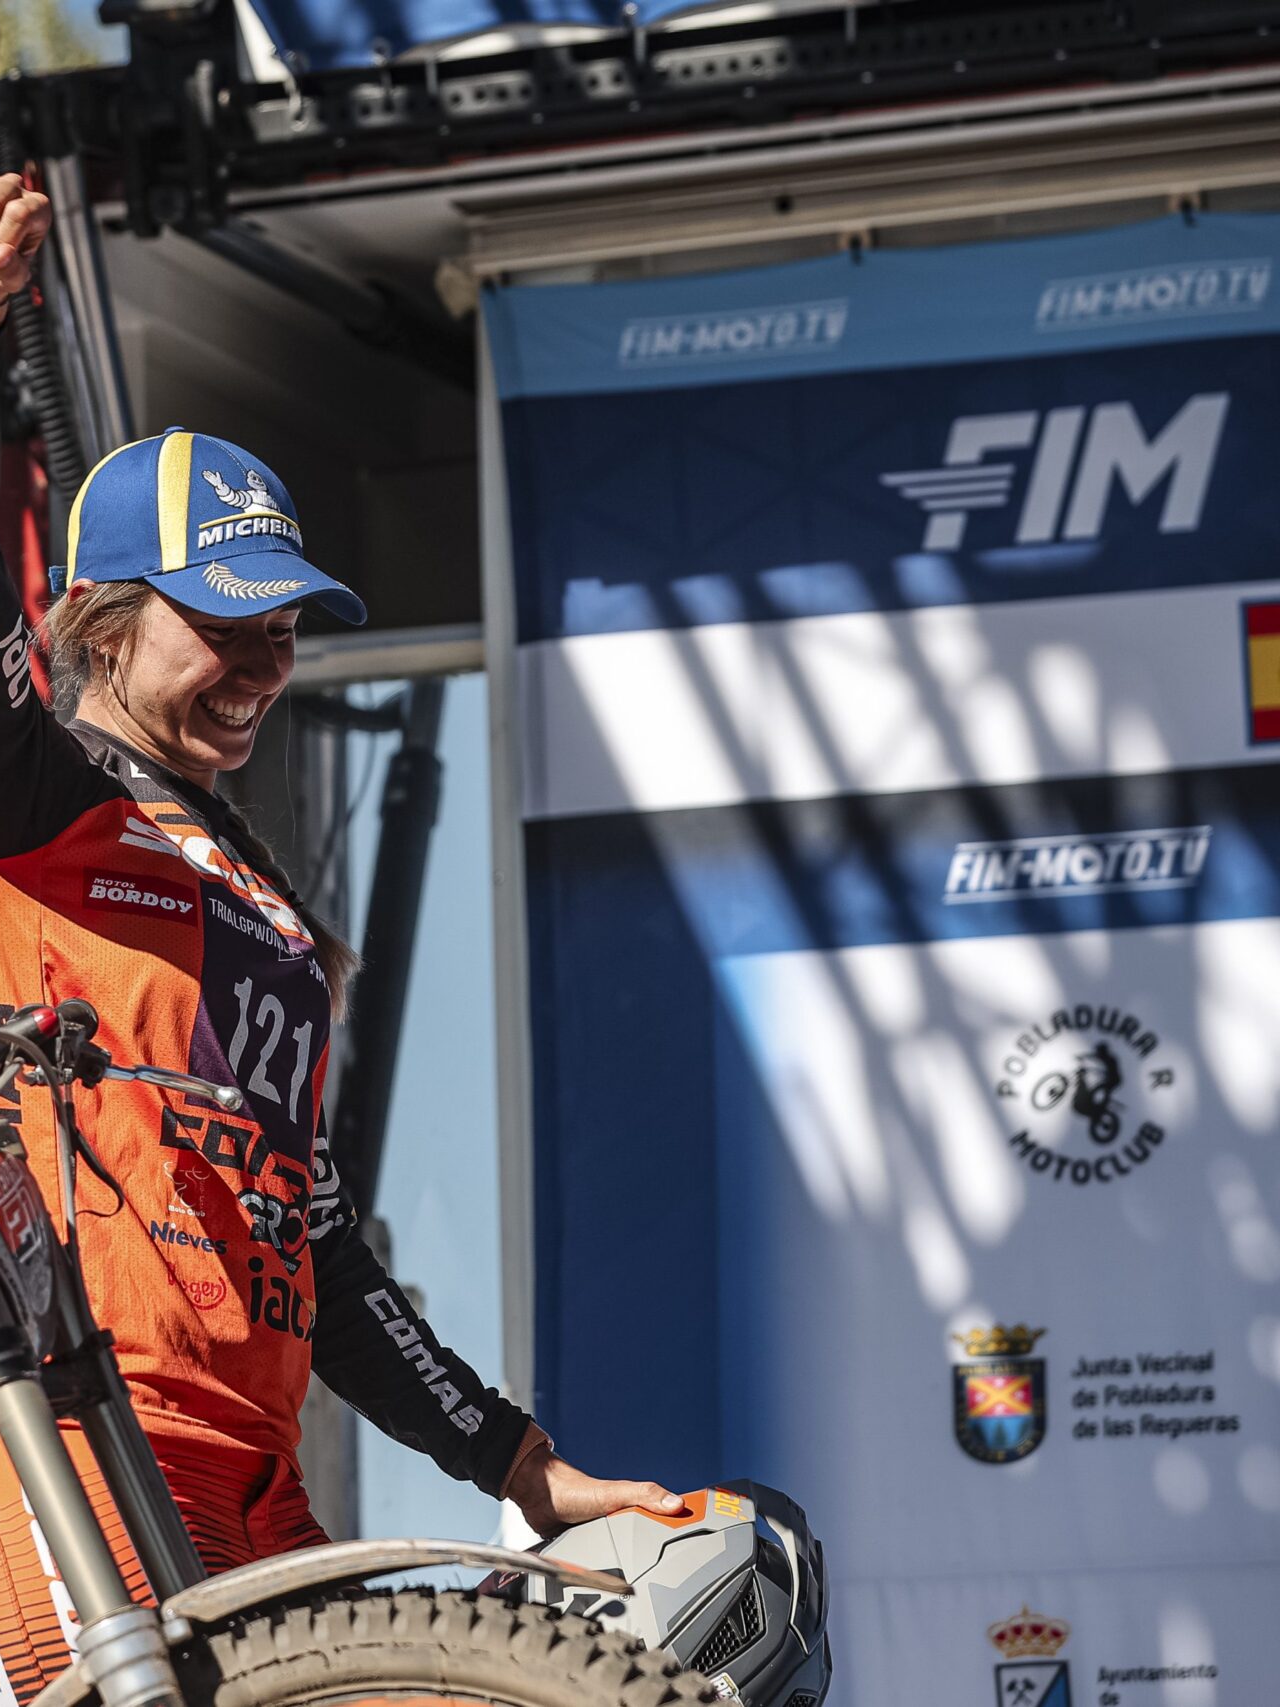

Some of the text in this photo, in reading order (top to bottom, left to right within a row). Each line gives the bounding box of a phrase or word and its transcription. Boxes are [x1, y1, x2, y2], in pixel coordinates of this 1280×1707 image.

[880, 392, 1229, 550] FIM
[198, 517, 303, 549] MICHELIN
[944, 836, 1211, 894] FIM-MOTO.TV
[89, 884, 193, 914] BORDOY
[94, 877, 136, 889] MOTOS
[228, 976, 313, 1124] 121
[997, 1004, 1160, 1098] POBLADURA
[1010, 1120, 1166, 1187] MOTOCLUB
[150, 1220, 228, 1255] Nieves
[364, 1288, 485, 1437] COMAS
[1072, 1350, 1215, 1378] Junta Vecinal
[1072, 1383, 1215, 1408] de Pobladura
[1072, 1413, 1240, 1441] de las Regueras
[1097, 1664, 1218, 1687] Ayuntamiento
